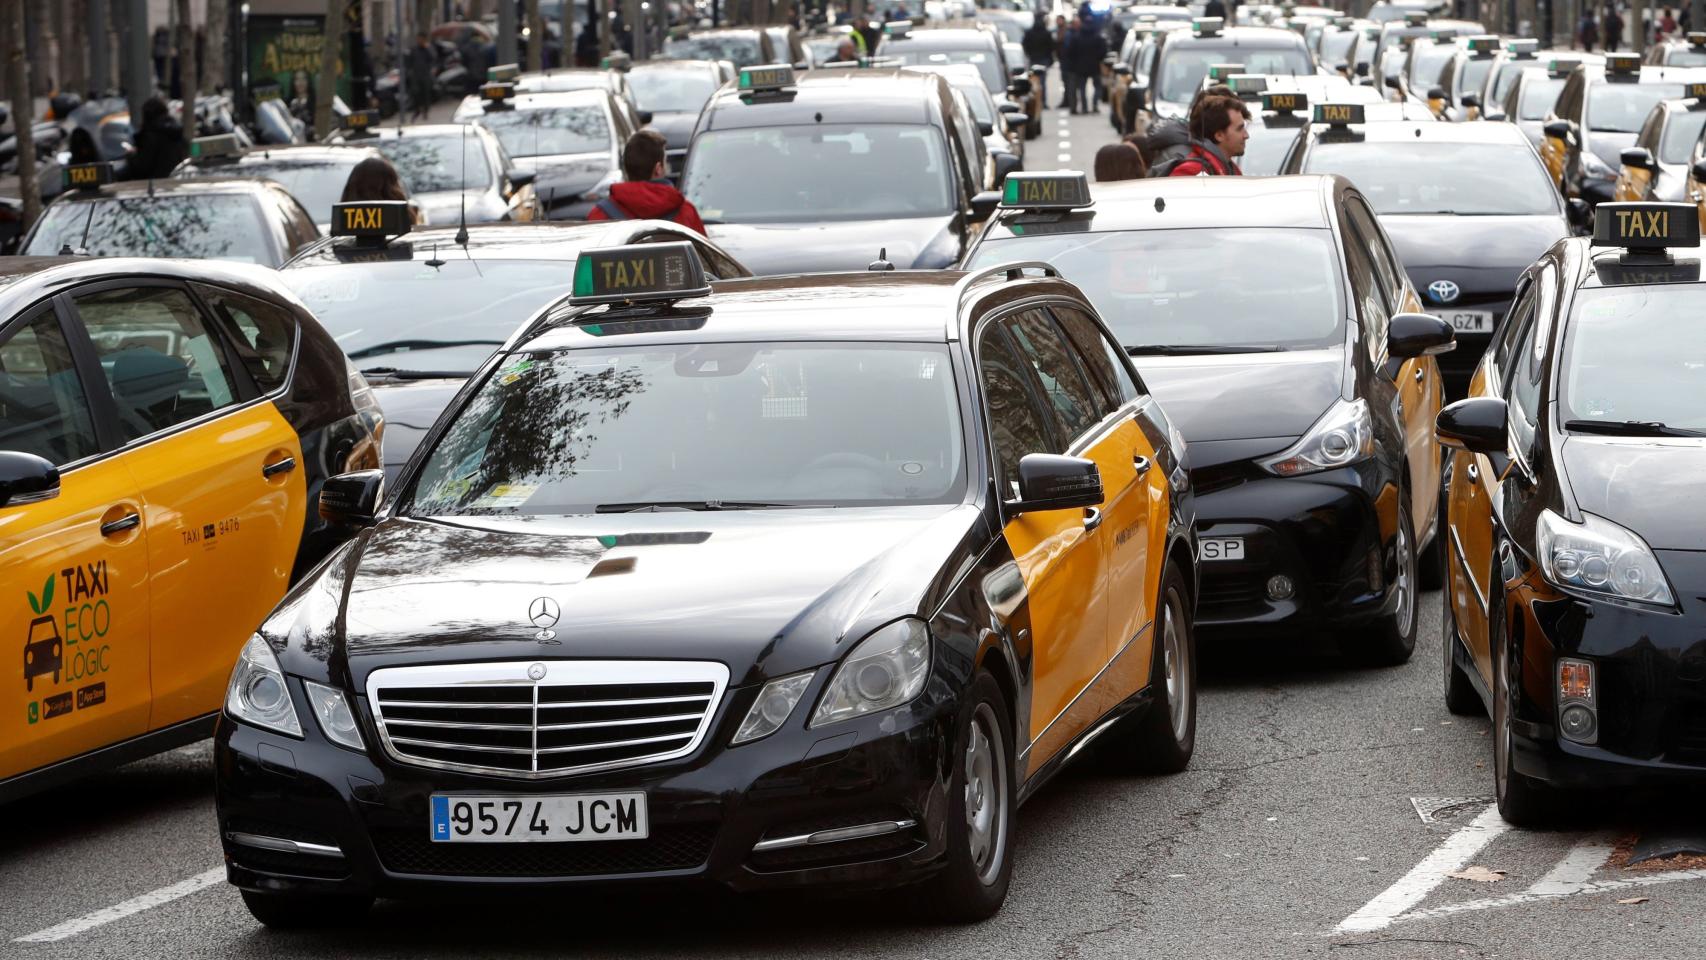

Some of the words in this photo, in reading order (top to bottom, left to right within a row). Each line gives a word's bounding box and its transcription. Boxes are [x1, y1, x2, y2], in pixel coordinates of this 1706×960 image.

[1271, 95, 1295, 108] TAXI
[1323, 106, 1351, 120] TAXI
[70, 167, 97, 183] TAXI
[1022, 181, 1057, 201] TAXI
[344, 208, 382, 229] TAXI
[1615, 211, 1668, 237] TAXI
[601, 259, 655, 288] TAXI
[1453, 314, 1483, 330] GZW
[182, 527, 200, 546] TAXI
[219, 517, 240, 536] 9476
[61, 560, 109, 603] TAXI
[65, 599, 110, 646] ECO
[438, 823, 446, 834] E
[453, 802, 549, 836] 9574
[566, 798, 637, 835] JCM
